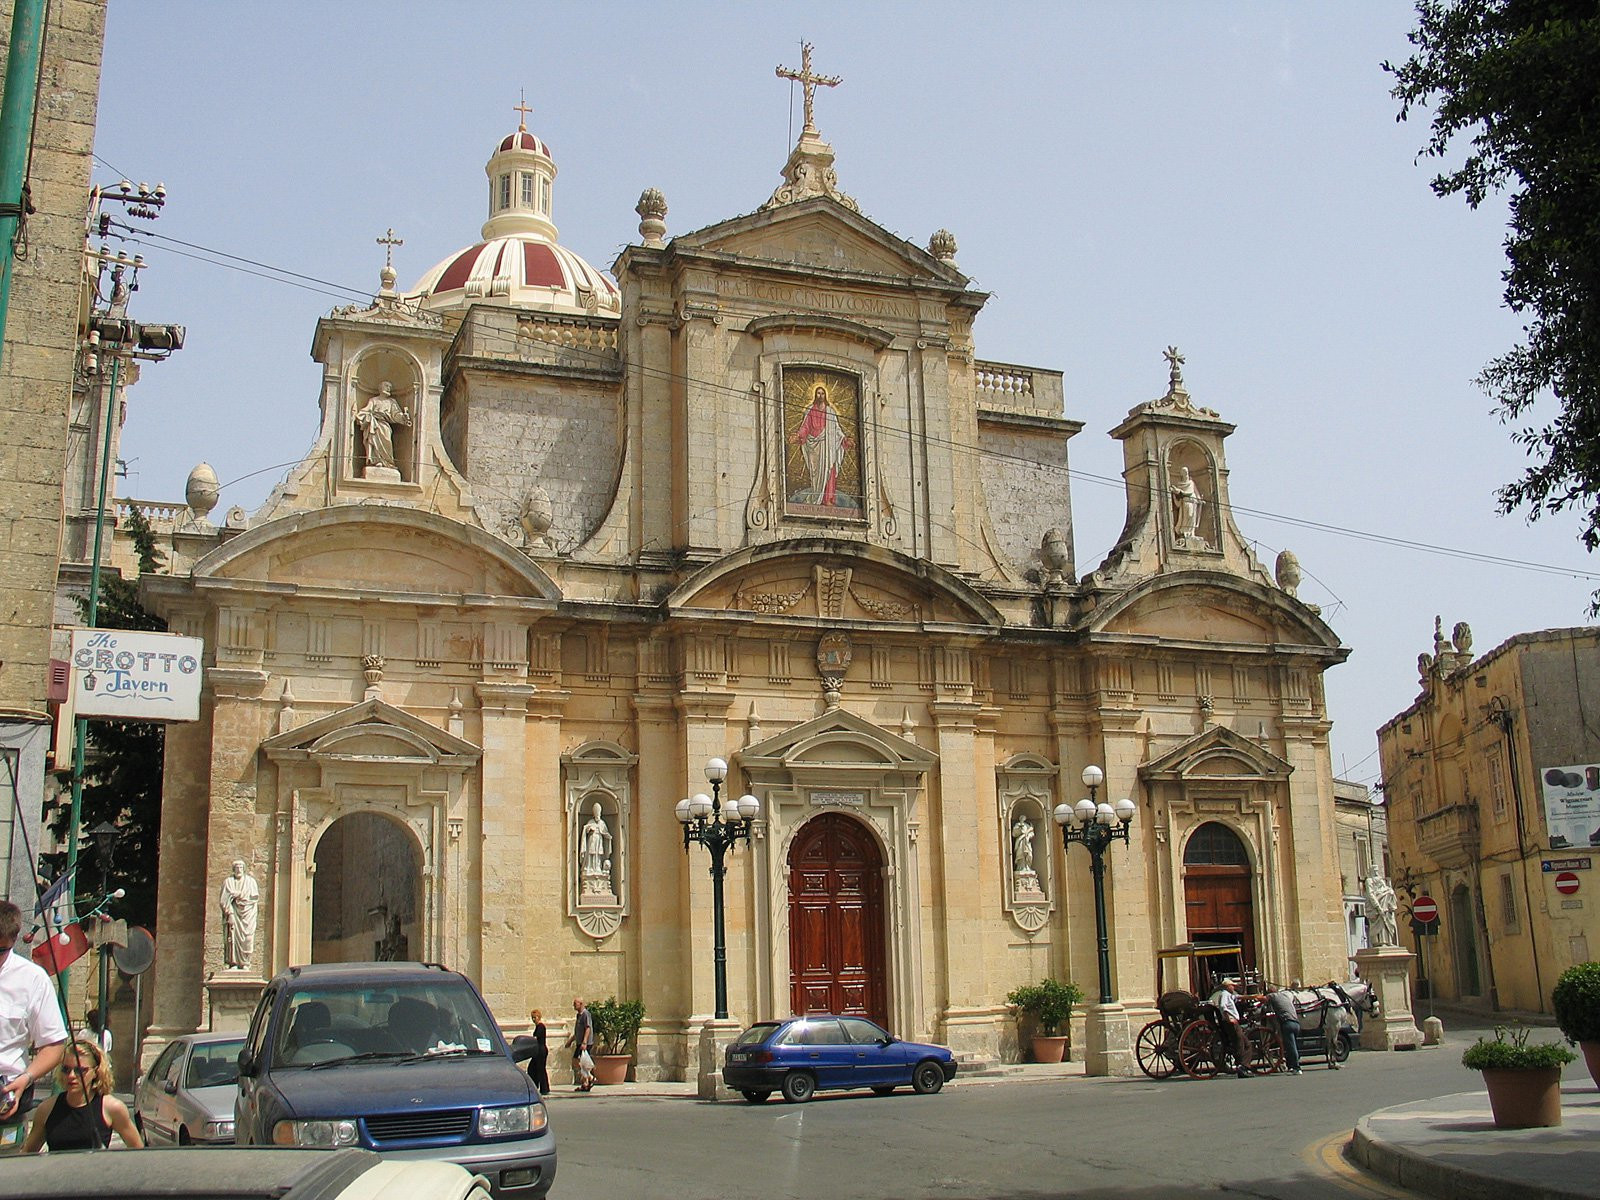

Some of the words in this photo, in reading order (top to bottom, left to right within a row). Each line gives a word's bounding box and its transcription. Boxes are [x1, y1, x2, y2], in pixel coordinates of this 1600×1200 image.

[87, 632, 118, 648] The
[74, 648, 198, 675] GROTTO
[106, 669, 168, 693] Tavern
